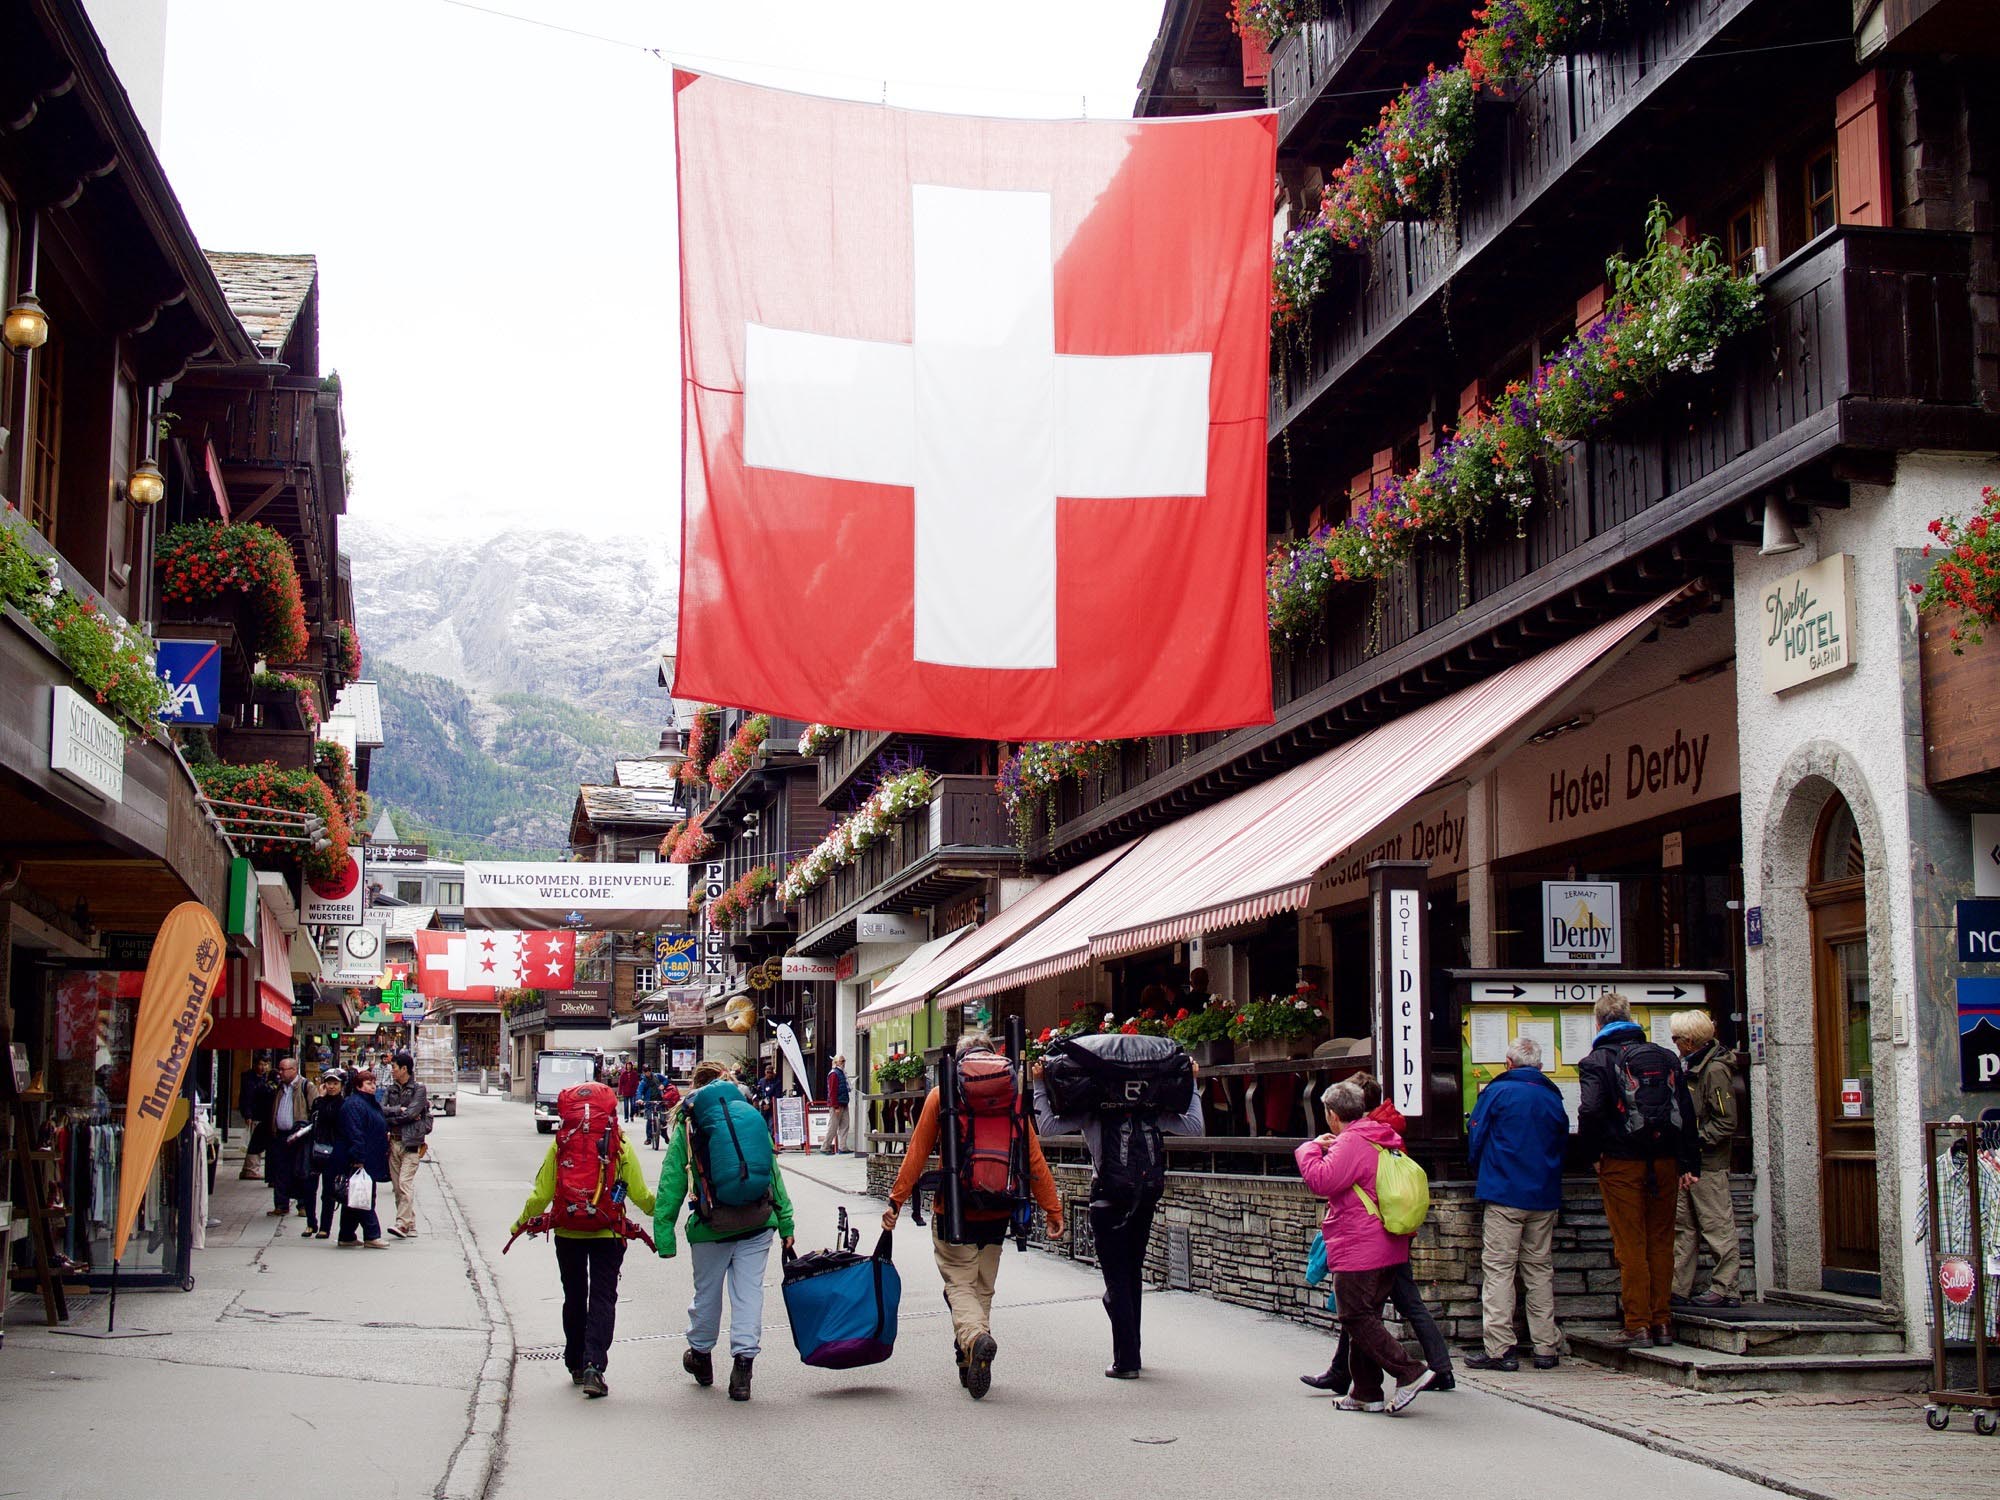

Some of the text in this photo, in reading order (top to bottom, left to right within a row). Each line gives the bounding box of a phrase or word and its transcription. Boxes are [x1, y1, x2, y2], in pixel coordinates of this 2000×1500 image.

[1766, 579, 1817, 646] Derby
[1784, 611, 1840, 661] HOTEL
[1810, 646, 1841, 670] GARNI
[69, 701, 123, 767] SCHLOSSBERG
[1549, 728, 1709, 823] Hotel Derby
[1411, 810, 1465, 864] Derby
[365, 847, 417, 857] OTEL POST
[479, 874, 675, 887] WILLKOMMEN. BIENVENUE.
[540, 887, 615, 899] WELCOME.
[1564, 890, 1598, 899] ZERMATT
[309, 904, 354, 912] METZGEREI
[364, 911, 392, 919] LACIER
[309, 913, 354, 921] WURSTEREI
[706, 864, 722, 974] POLUX
[889, 928, 906, 936] Bank
[1552, 911, 1612, 959] Derby
[663, 961, 689, 971] T-BAR
[786, 964, 835, 973] 24-h-Zone
[1399, 894, 1414, 1108] HOTEL Derby
[643, 1013, 669, 1022] WALLI
[138, 972, 208, 1121] Timberland
[1942, 1270, 1969, 1289] Sale!
